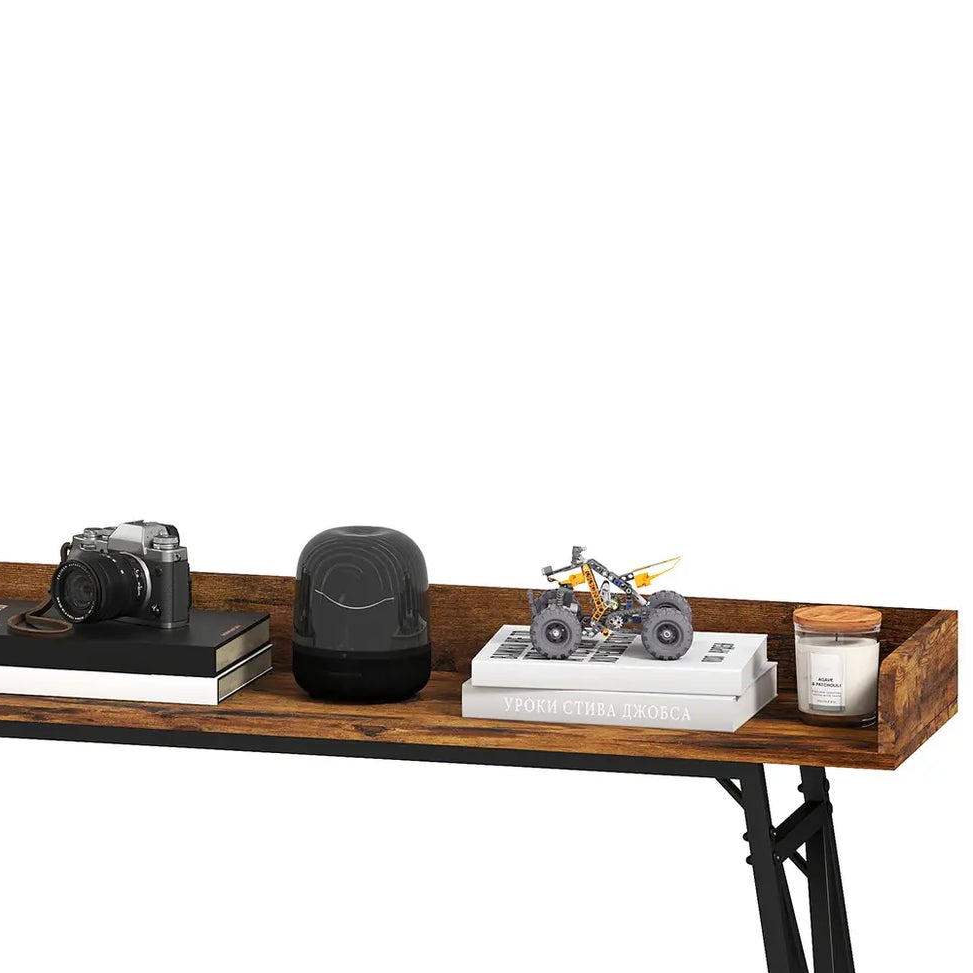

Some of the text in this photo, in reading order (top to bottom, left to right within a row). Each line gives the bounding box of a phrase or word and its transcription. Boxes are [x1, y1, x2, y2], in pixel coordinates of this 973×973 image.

[504, 697, 692, 721] УРОКИ СТИВА ДЖОБСА
